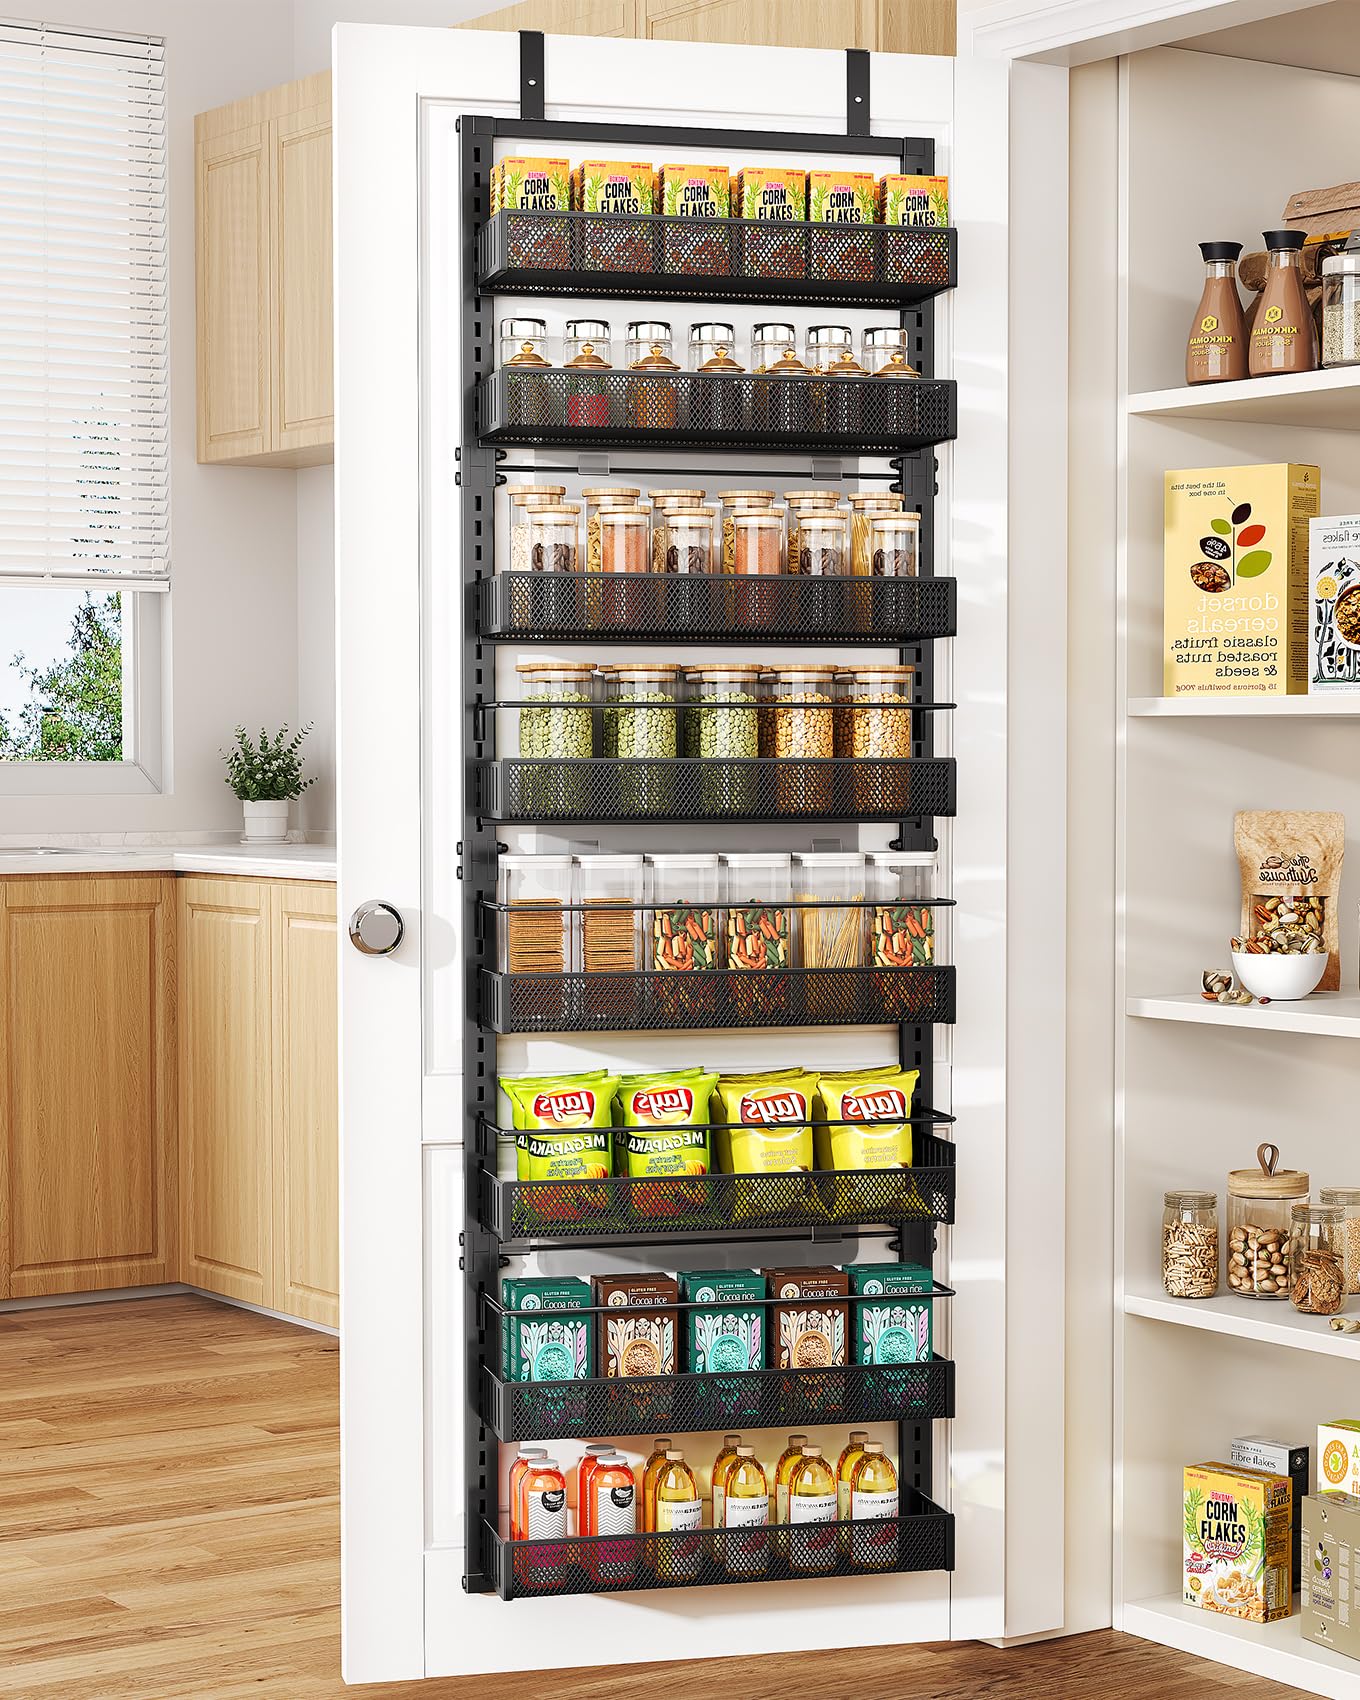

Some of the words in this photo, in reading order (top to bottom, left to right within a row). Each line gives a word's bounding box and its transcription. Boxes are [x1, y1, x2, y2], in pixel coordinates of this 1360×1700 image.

[524, 179, 549, 196] CORN
[605, 182, 631, 198] CORN
[684, 185, 709, 201] CORN
[521, 195, 555, 210] FLAKES
[762, 189, 786, 205] CORN
[830, 192, 854, 208] CORN
[906, 195, 929, 211] CORN
[601, 198, 638, 213] FLAKES
[680, 202, 715, 217] FLAKES
[759, 205, 792, 220] FLAKES
[826, 208, 860, 223] FLAKES
[902, 211, 935, 226] FLAKES
[718, 1292, 741, 1301] Cocoa
[742, 1291, 755, 1300] rice
[802, 1288, 824, 1297] Cocoa
[826, 1287, 838, 1297] rice
[886, 1285, 908, 1294] Cocoa
[910, 1284, 922, 1293] rice
[543, 1300, 566, 1308] Cocoa
[568, 1298, 580, 1308] rice
[630, 1296, 653, 1305] Cocoa
[655, 1295, 667, 1304] rice
[1231, 1451, 1251, 1463] Fibre
[1253, 1455, 1276, 1468] flakes
[1274, 1487, 1287, 1498] CORN
[1271, 1494, 1290, 1508] FLAKES
[1206, 1501, 1238, 1522] CORN
[1201, 1521, 1246, 1543] FLAKES
